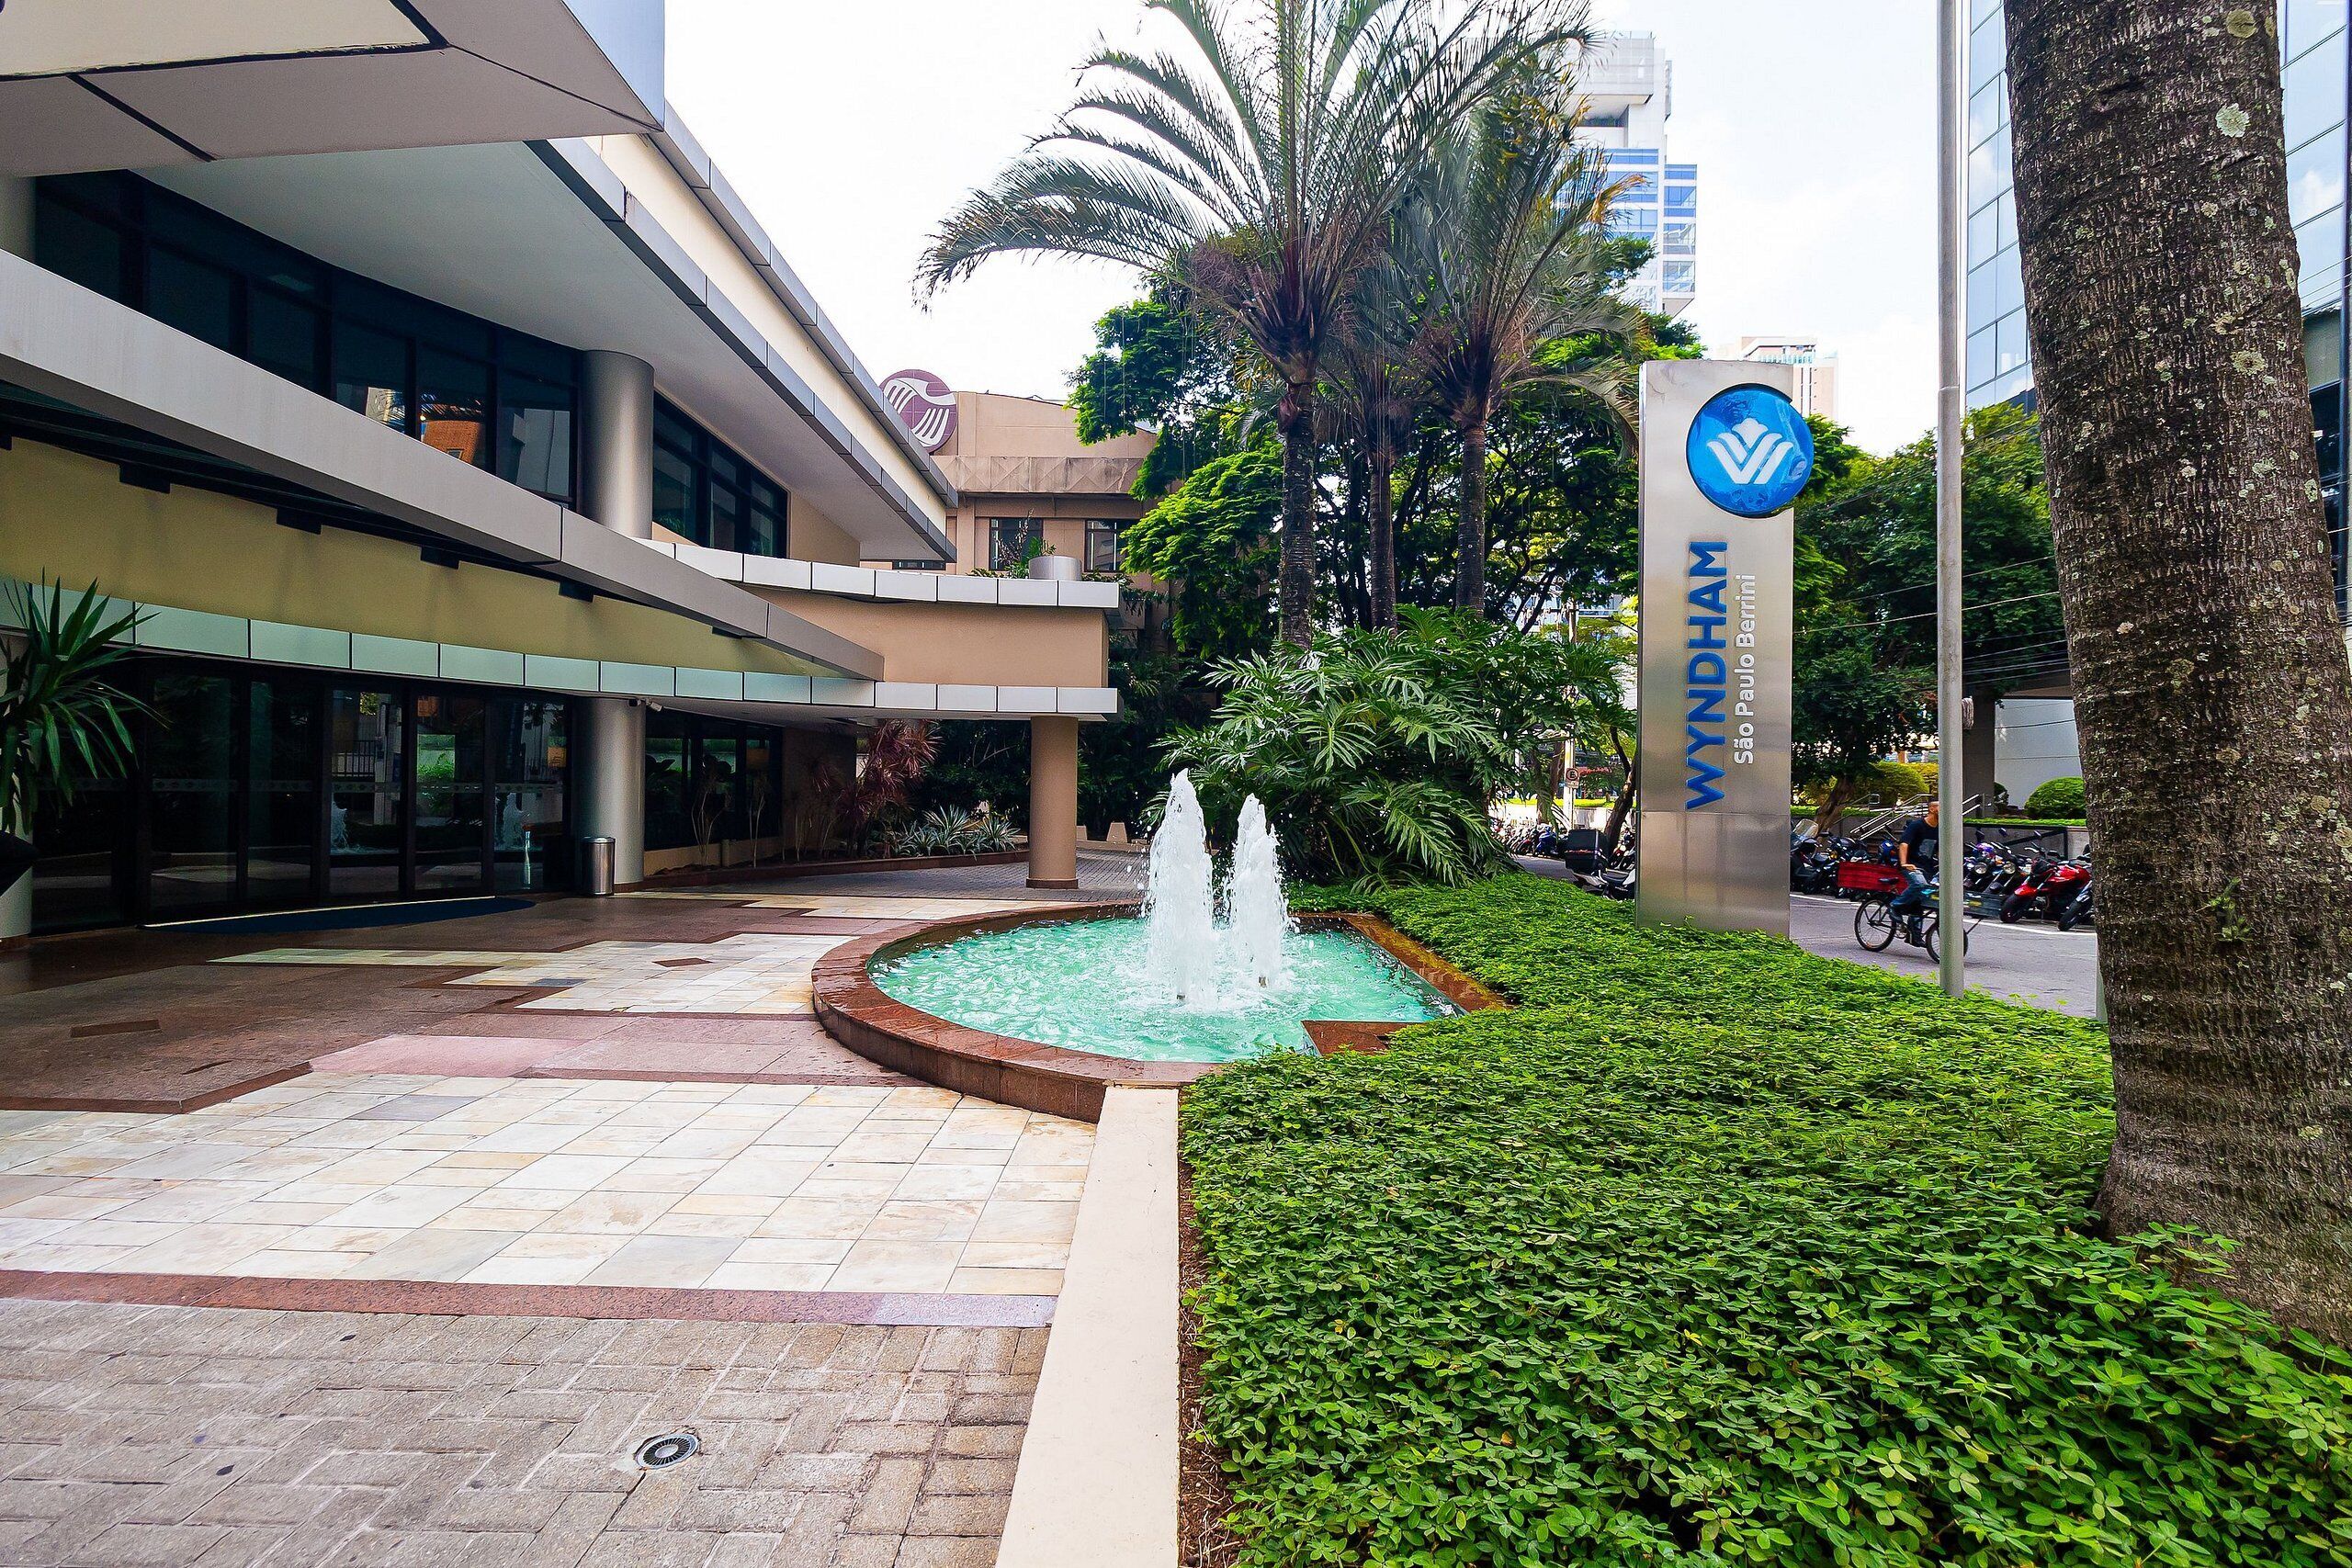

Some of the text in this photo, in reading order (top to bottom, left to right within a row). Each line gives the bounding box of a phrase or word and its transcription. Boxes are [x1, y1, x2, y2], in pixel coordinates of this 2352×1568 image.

[1686, 541, 1727, 810] WYNDHAM
[1734, 575, 1755, 764] São Paulo Berrini
